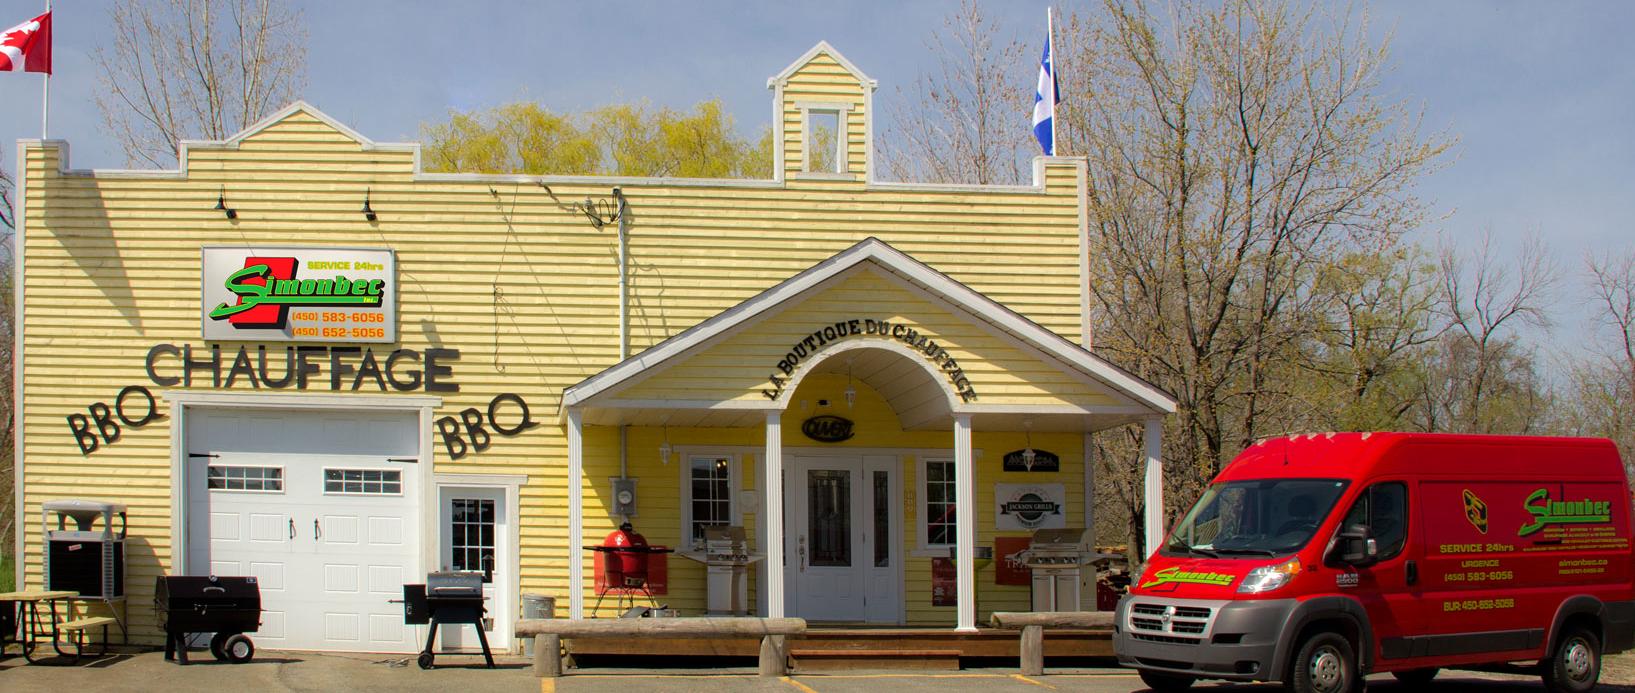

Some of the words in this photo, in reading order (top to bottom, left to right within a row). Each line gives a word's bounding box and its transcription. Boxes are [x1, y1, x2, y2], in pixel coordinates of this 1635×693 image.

[307, 261, 351, 271] SERVICE
[354, 262, 384, 271] 24hrs
[209, 264, 386, 321] Simonbec
[291, 312, 318, 322] (450)
[322, 312, 384, 323] 583-6056
[291, 328, 318, 337] (450)
[322, 328, 384, 338] 652-5056
[145, 343, 460, 393] CHAUFFAGE
[761, 374, 787, 401] LA
[777, 319, 861, 376] BOUTIQUE
[864, 319, 890, 336] DU
[892, 324, 978, 404] CHAUFFAGE
[67, 385, 166, 457] BBQ
[437, 393, 540, 460] BBQ
[1517, 488, 1611, 536] Simonbec
[1440, 544, 1483, 553] SERVICE
[1486, 543, 1514, 552] 24hrs
[1461, 560, 1500, 568] URGENCE
[1141, 566, 1236, 588] Simonbec
[1444, 573, 1465, 582] (450)
[1467, 571, 1513, 581] 583-6056
